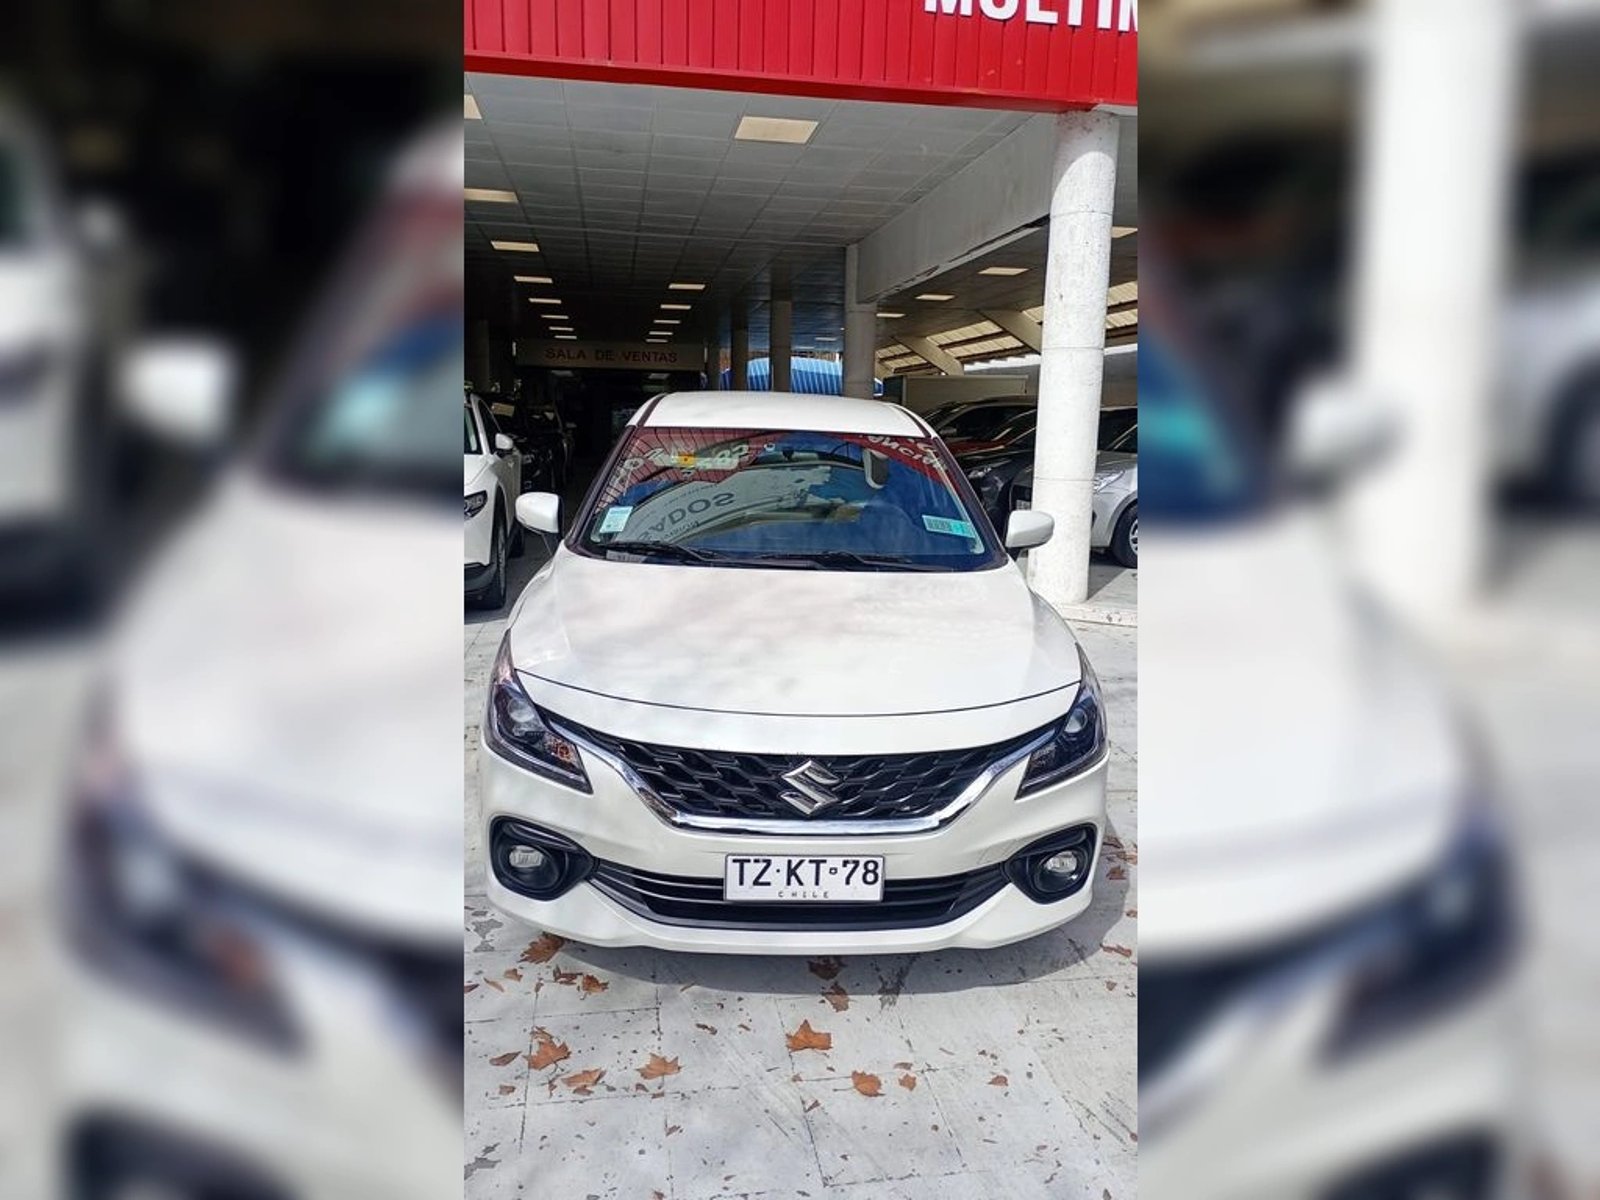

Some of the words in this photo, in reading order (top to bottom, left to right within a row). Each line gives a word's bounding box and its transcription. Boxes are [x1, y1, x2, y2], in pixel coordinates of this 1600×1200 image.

[545, 348, 586, 360] SALA
[594, 350, 616, 361] DE
[622, 351, 678, 363] VENTAS
[778, 891, 829, 899] CHILE
